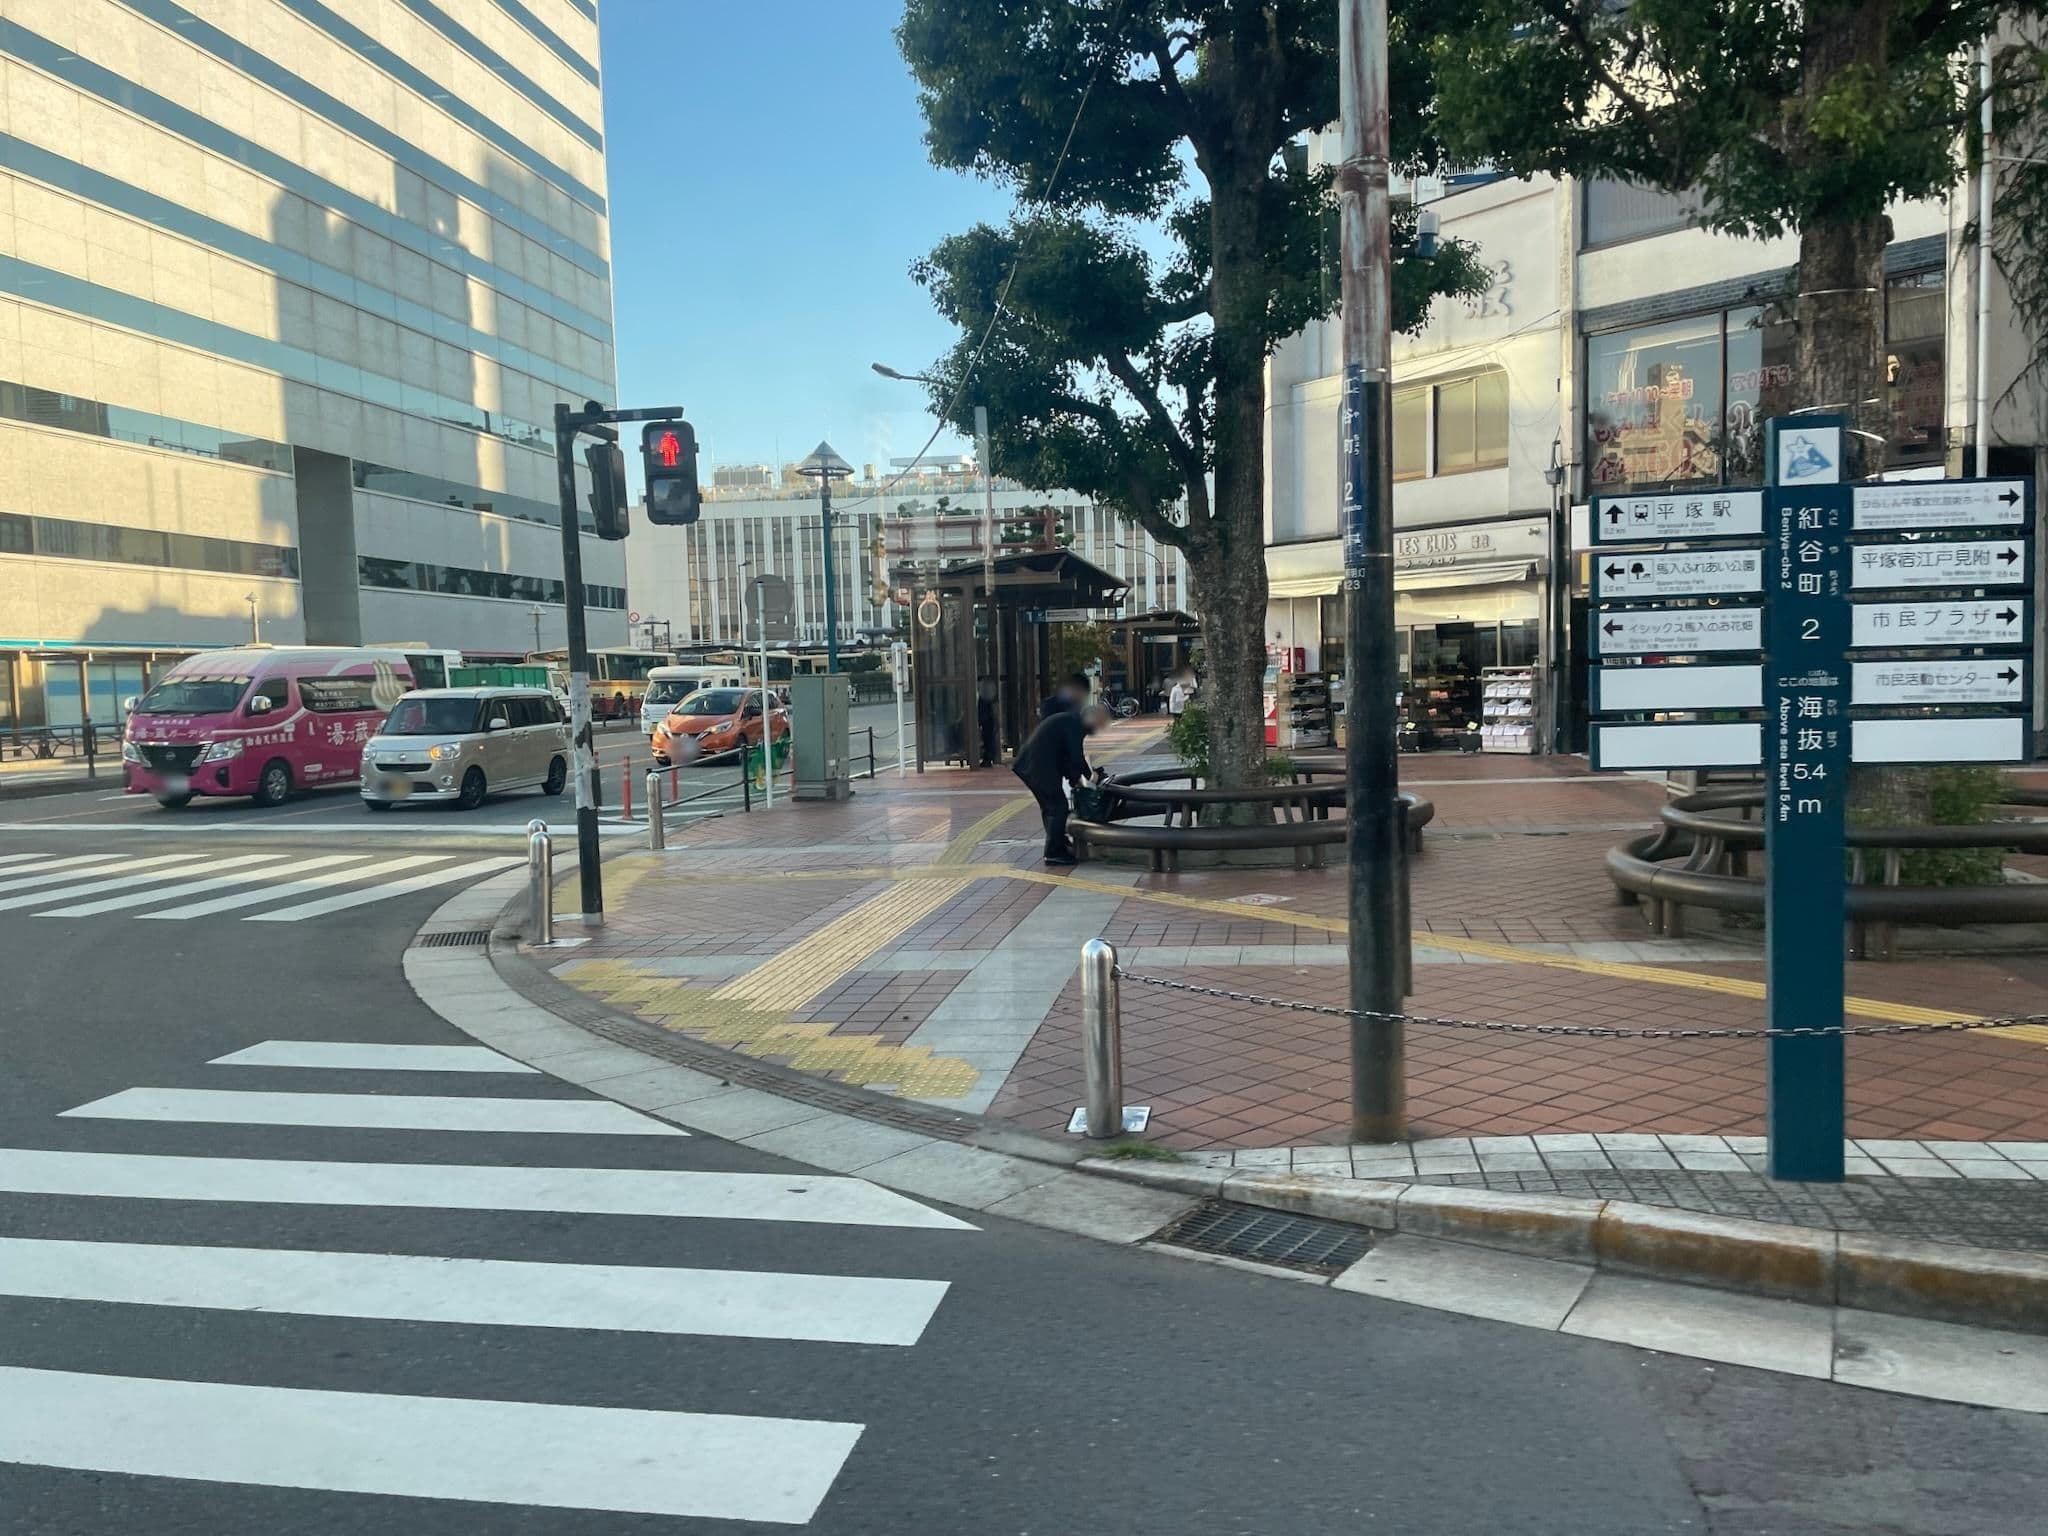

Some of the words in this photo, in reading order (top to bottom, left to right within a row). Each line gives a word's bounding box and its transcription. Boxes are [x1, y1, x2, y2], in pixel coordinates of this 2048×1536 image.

[1344, 482, 1354, 501] 2
[1657, 500, 1731, 520] 平塚駅
[1399, 537, 1421, 555] LES
[1426, 533, 1457, 553] CLOS
[1781, 507, 1792, 579] Beniya-cho
[1798, 507, 1824, 594] 紅谷町
[1861, 549, 1990, 568] 平塚宿江戸見附
[1781, 581, 1792, 589] 2
[1873, 609, 1990, 627] 市民プラザ
[1801, 619, 1821, 639] 2
[1876, 672, 1991, 686] 市民活動センター
[1780, 697, 1791, 735] Above
[1798, 696, 1823, 750] 海抜
[1780, 739, 1789, 760] sea
[1780, 763, 1791, 791] level
[1793, 763, 1827, 780] 5.4
[1780, 794, 1791, 822] 5.4m
[1798, 798, 1821, 814] m
